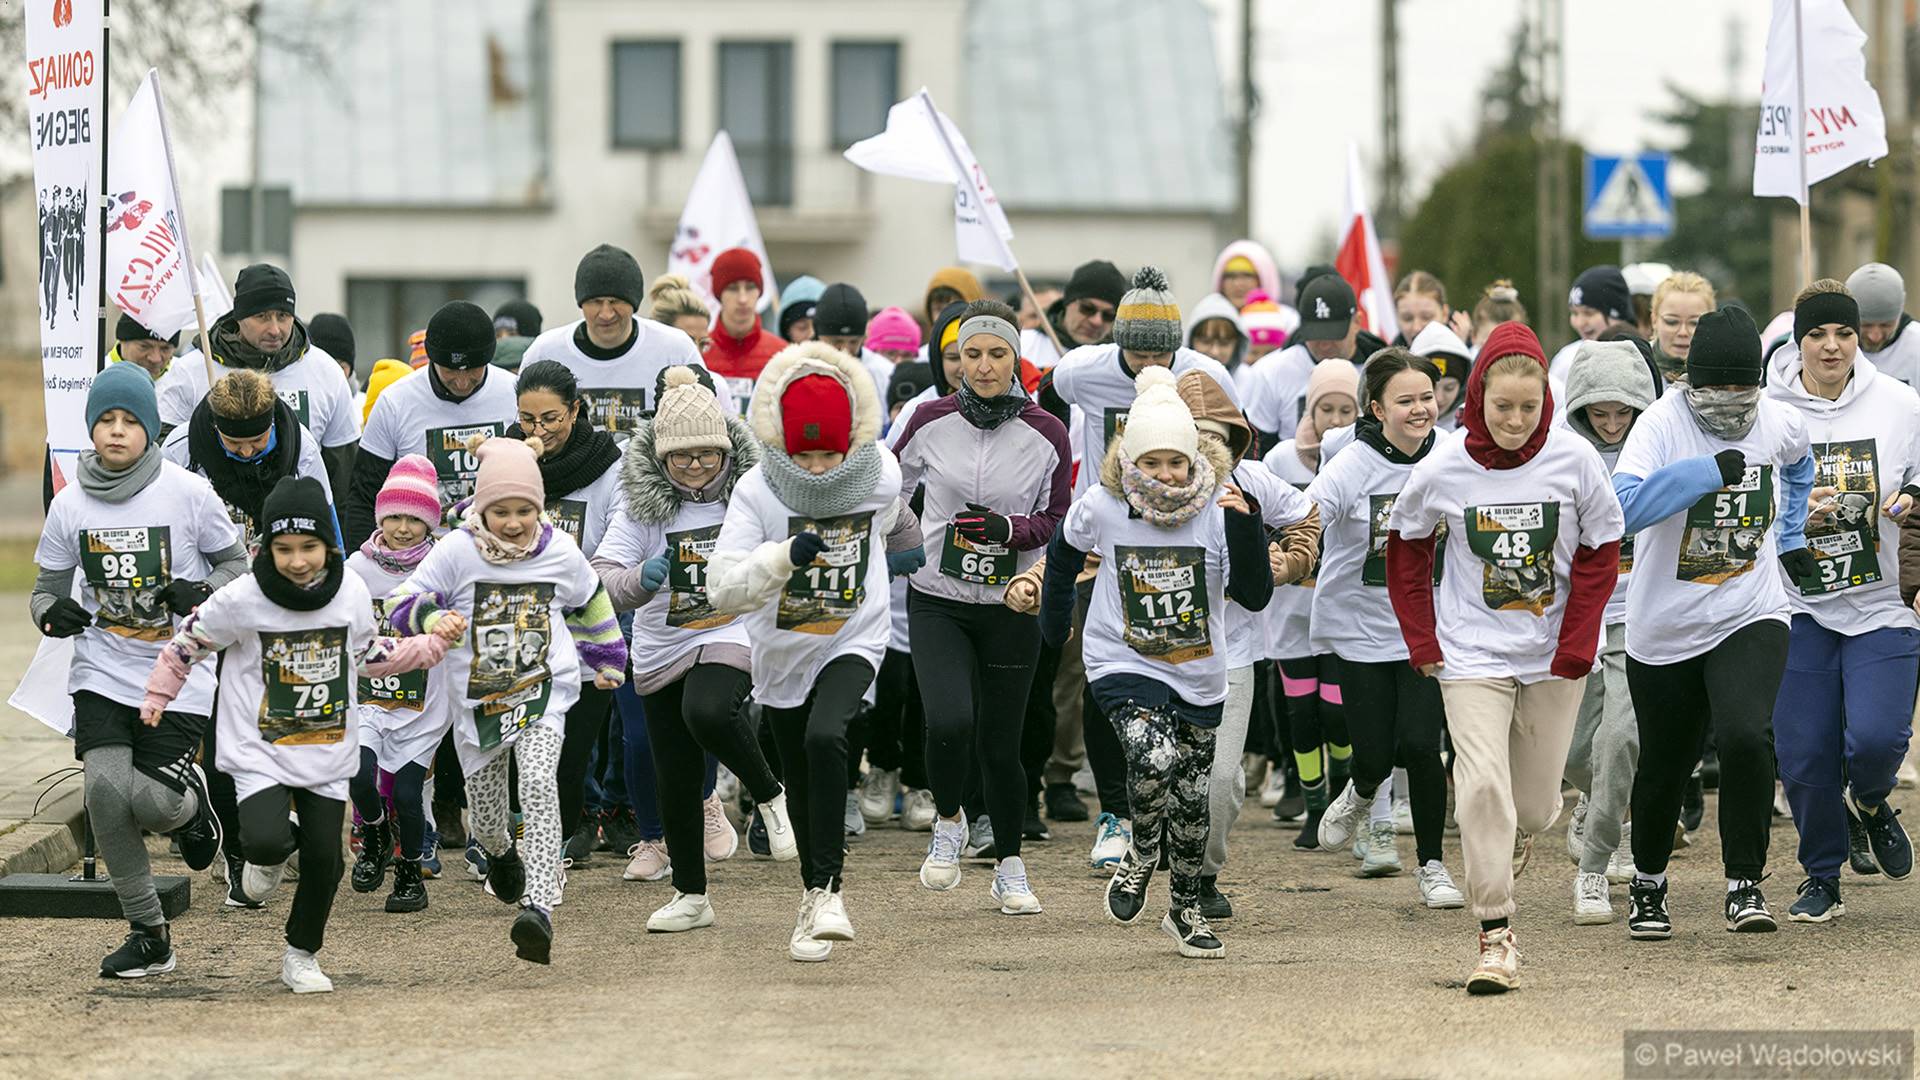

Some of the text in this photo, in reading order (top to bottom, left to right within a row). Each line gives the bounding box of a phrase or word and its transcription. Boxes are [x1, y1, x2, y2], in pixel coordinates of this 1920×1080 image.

[1714, 494, 1748, 518] 51
[271, 517, 316, 533] NEW YORK
[1492, 532, 1531, 559] 48
[101, 554, 137, 580] 98
[805, 566, 857, 590] 111
[961, 554, 996, 578] 66
[1818, 555, 1856, 582] 37
[1139, 590, 1195, 619] 112
[293, 683, 331, 709] 79
[500, 703, 528, 735] 80
